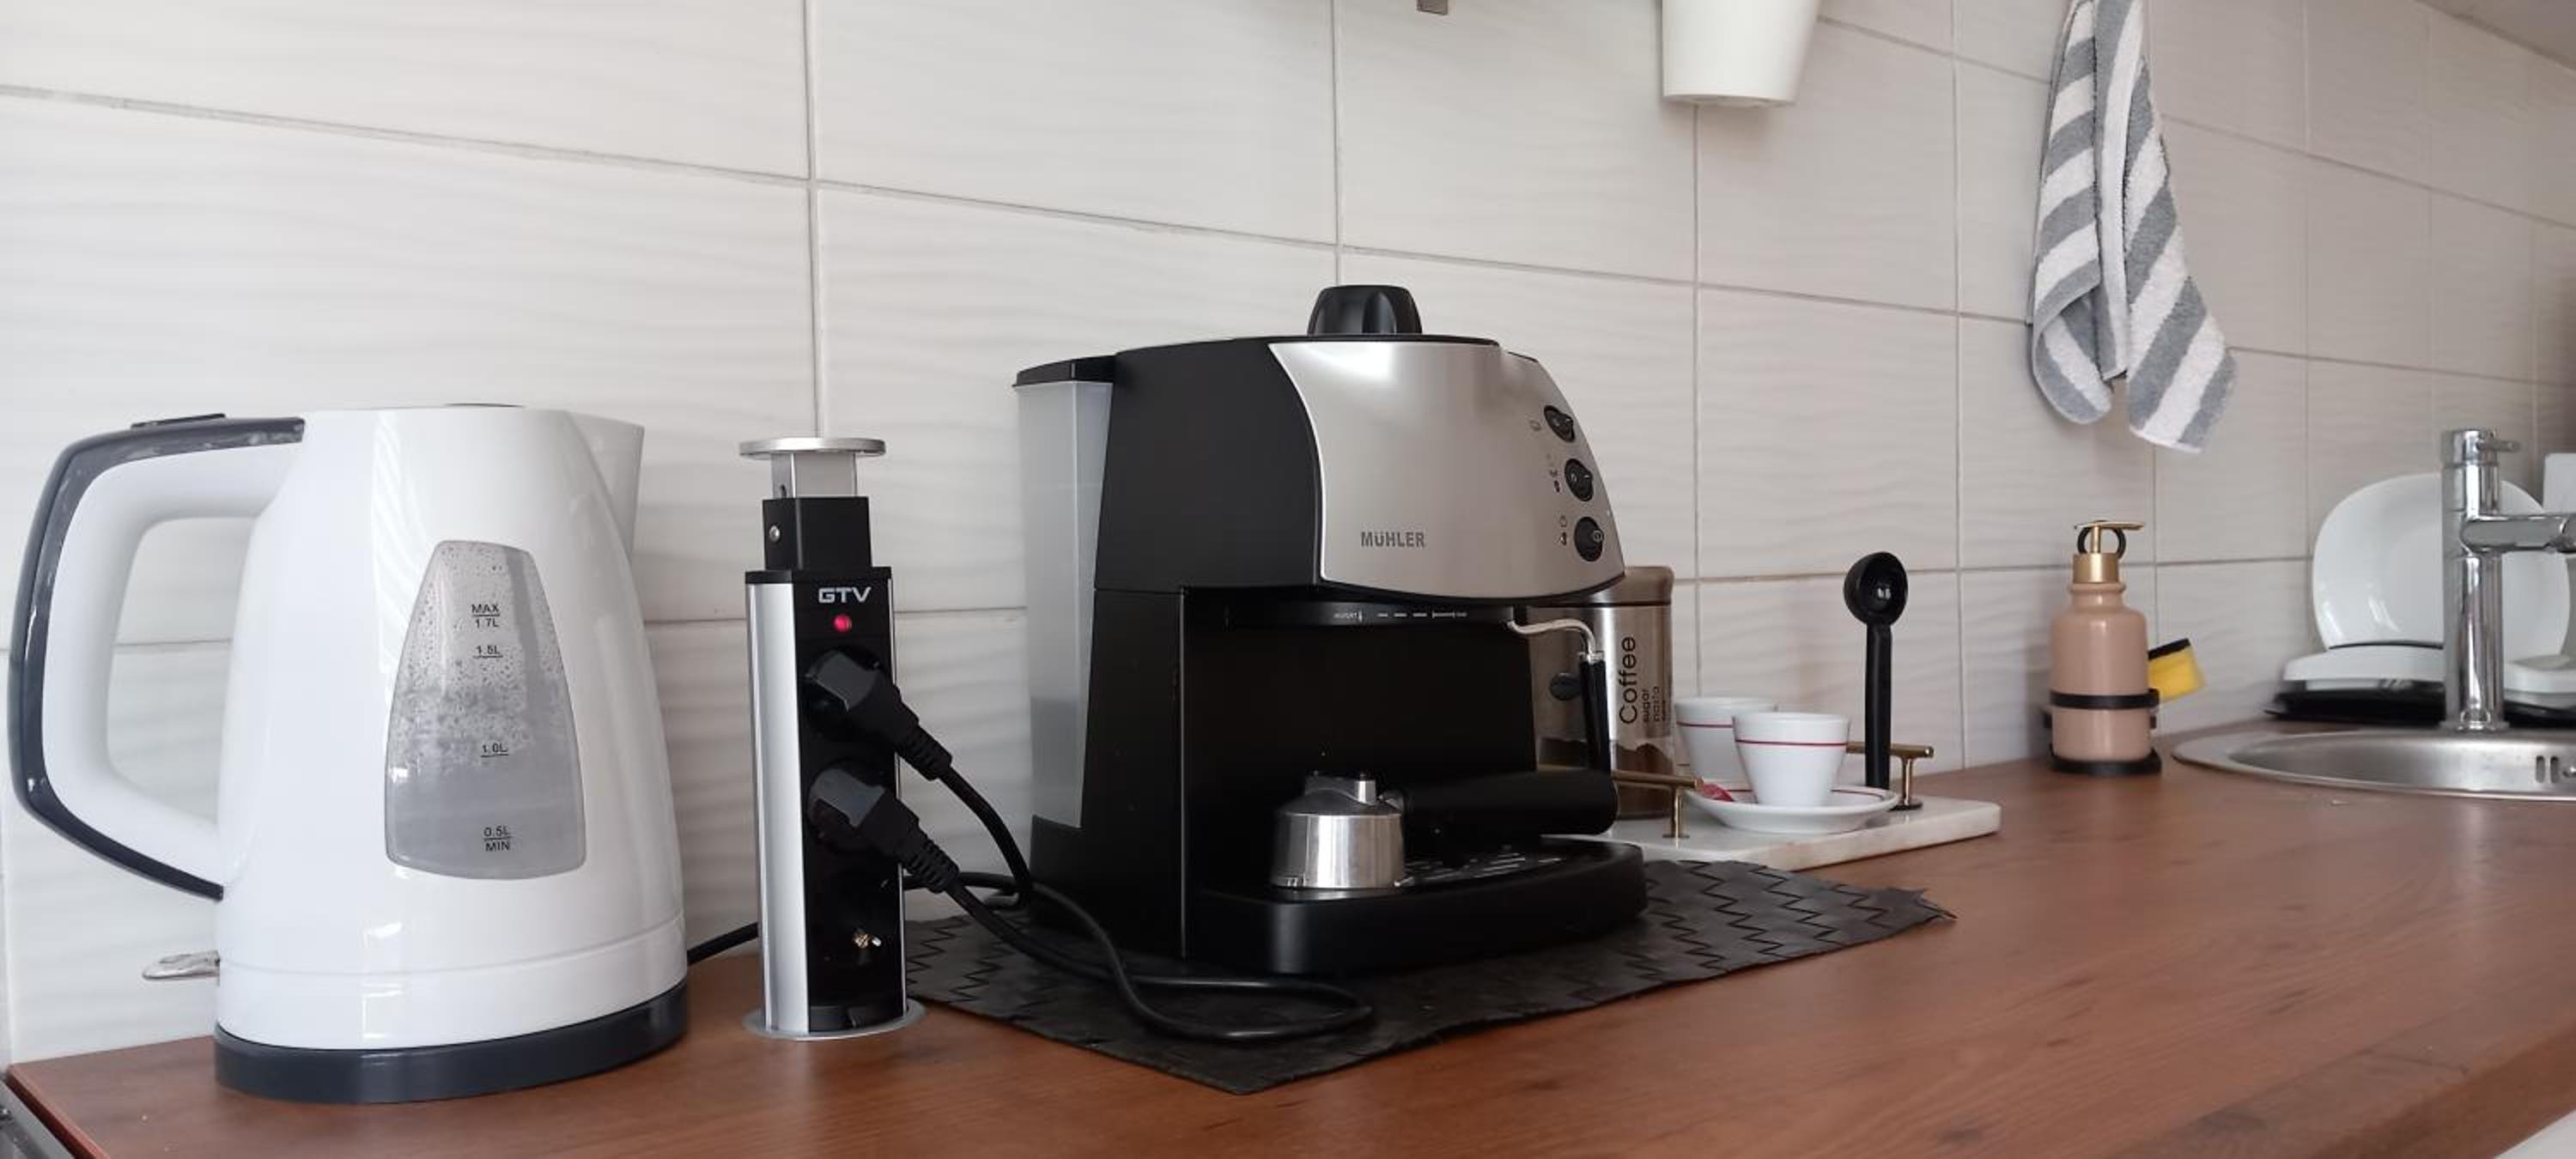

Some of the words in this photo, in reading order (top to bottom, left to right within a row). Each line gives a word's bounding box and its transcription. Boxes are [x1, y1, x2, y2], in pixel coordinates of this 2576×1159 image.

[1361, 531, 1425, 548] MÜHLER
[817, 586, 872, 604] GTV
[471, 604, 500, 614] MAX
[474, 618, 501, 628] 1.7L
[1619, 636, 1637, 724] Coffee
[483, 826, 510, 837] 0.5L
[485, 840, 510, 852] MIN
